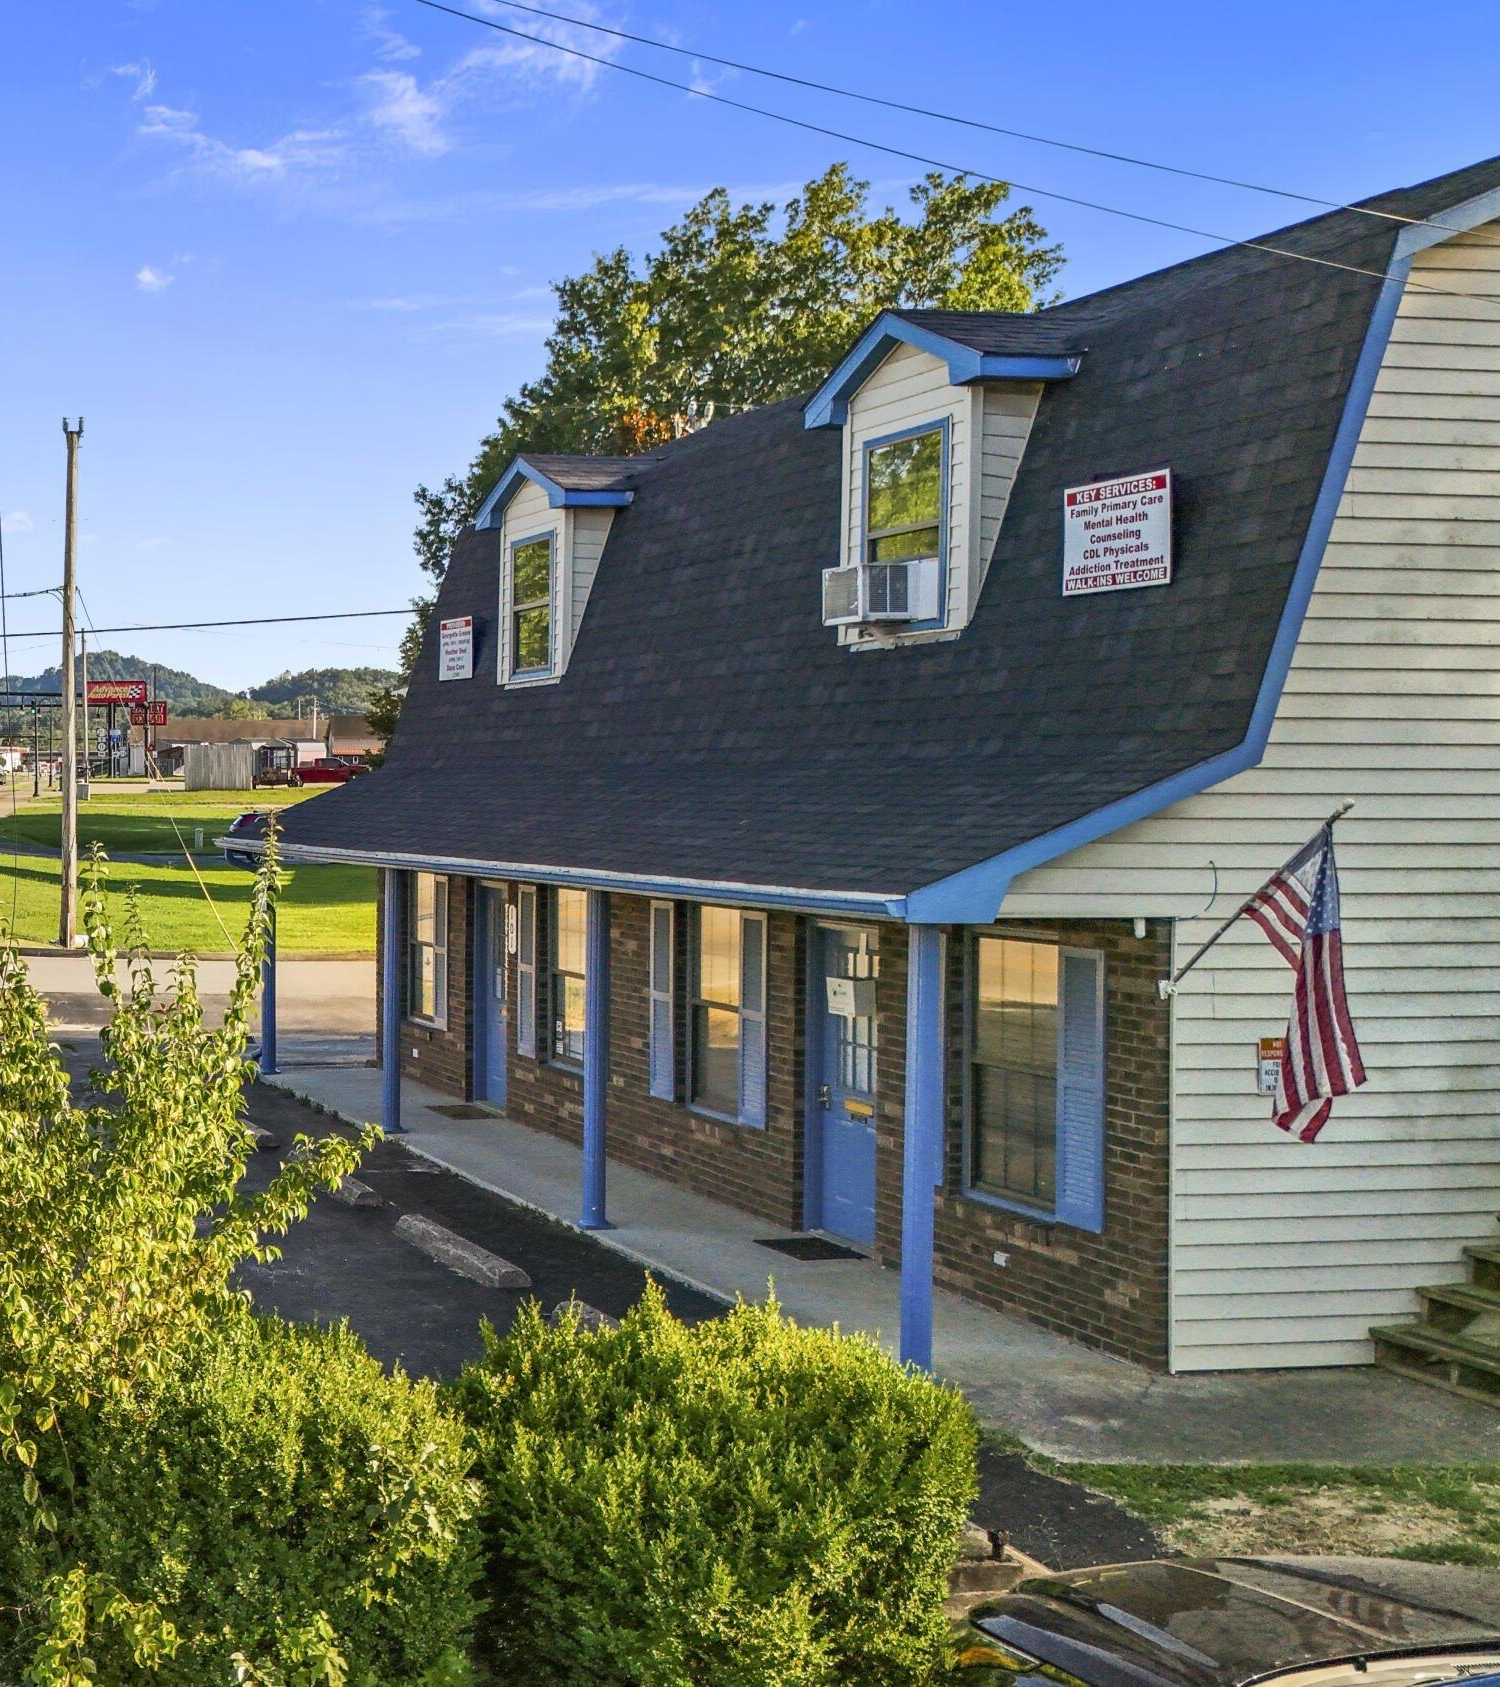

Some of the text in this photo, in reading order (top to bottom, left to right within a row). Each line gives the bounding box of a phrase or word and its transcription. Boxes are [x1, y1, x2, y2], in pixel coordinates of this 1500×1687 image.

[1076, 479, 1156, 504] KEY SERVICES:
[1070, 495, 1164, 519] Family Primary Care
[1084, 511, 1148, 531] Mental Health
[1090, 529, 1141, 544] Counseling
[1083, 542, 1149, 560] CDL Physicals
[1069, 555, 1164, 577] Addiction Treatment
[1067, 568, 1165, 591] WALK-INS WELCOME
